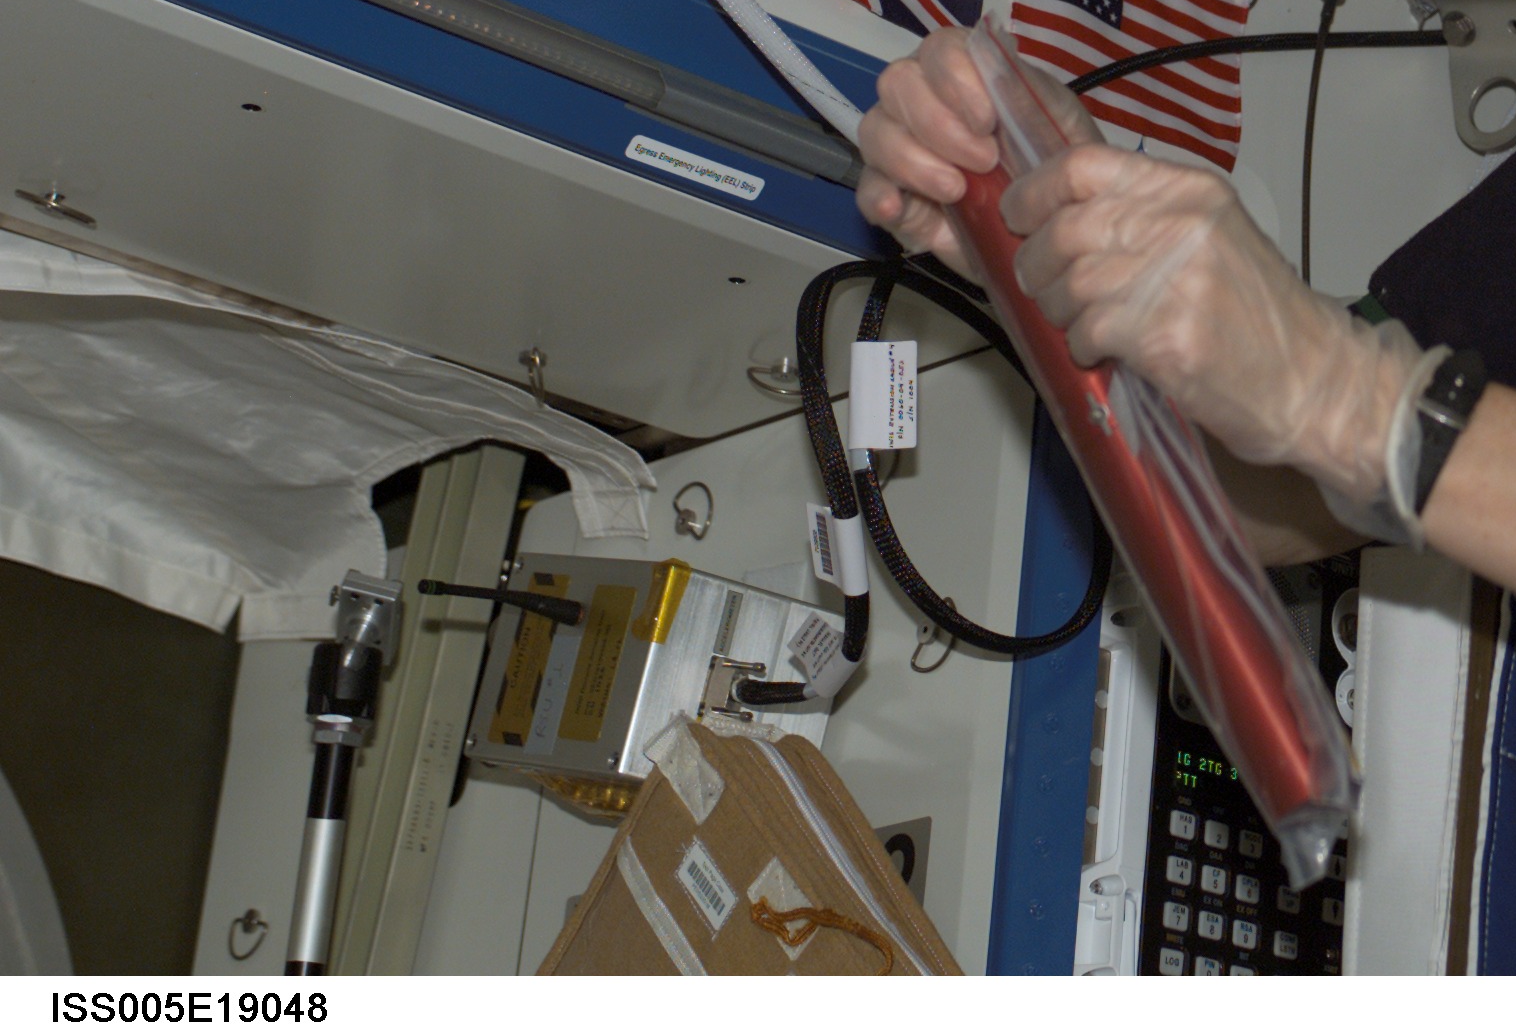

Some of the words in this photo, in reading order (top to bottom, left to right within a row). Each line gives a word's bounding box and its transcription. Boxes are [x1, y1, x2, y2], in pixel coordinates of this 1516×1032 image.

[634, 143, 658, 160] Egress
[658, 152, 694, 172] Emergency
[694, 164, 721, 183] Lighting
[721, 174, 740, 189] (EEL)
[740, 180, 756, 194] Strip
[509, 625, 531, 688] CAUTION
[1200, 758, 1221, 776] 2TG
[1216, 834, 1221, 843] 2
[1176, 859, 1189, 869] LAB
[1179, 871, 1184, 880] 4
[1213, 880, 1218, 889] 5
[1176, 916, 1181, 925] 7
[1210, 925, 1215, 934] 8
